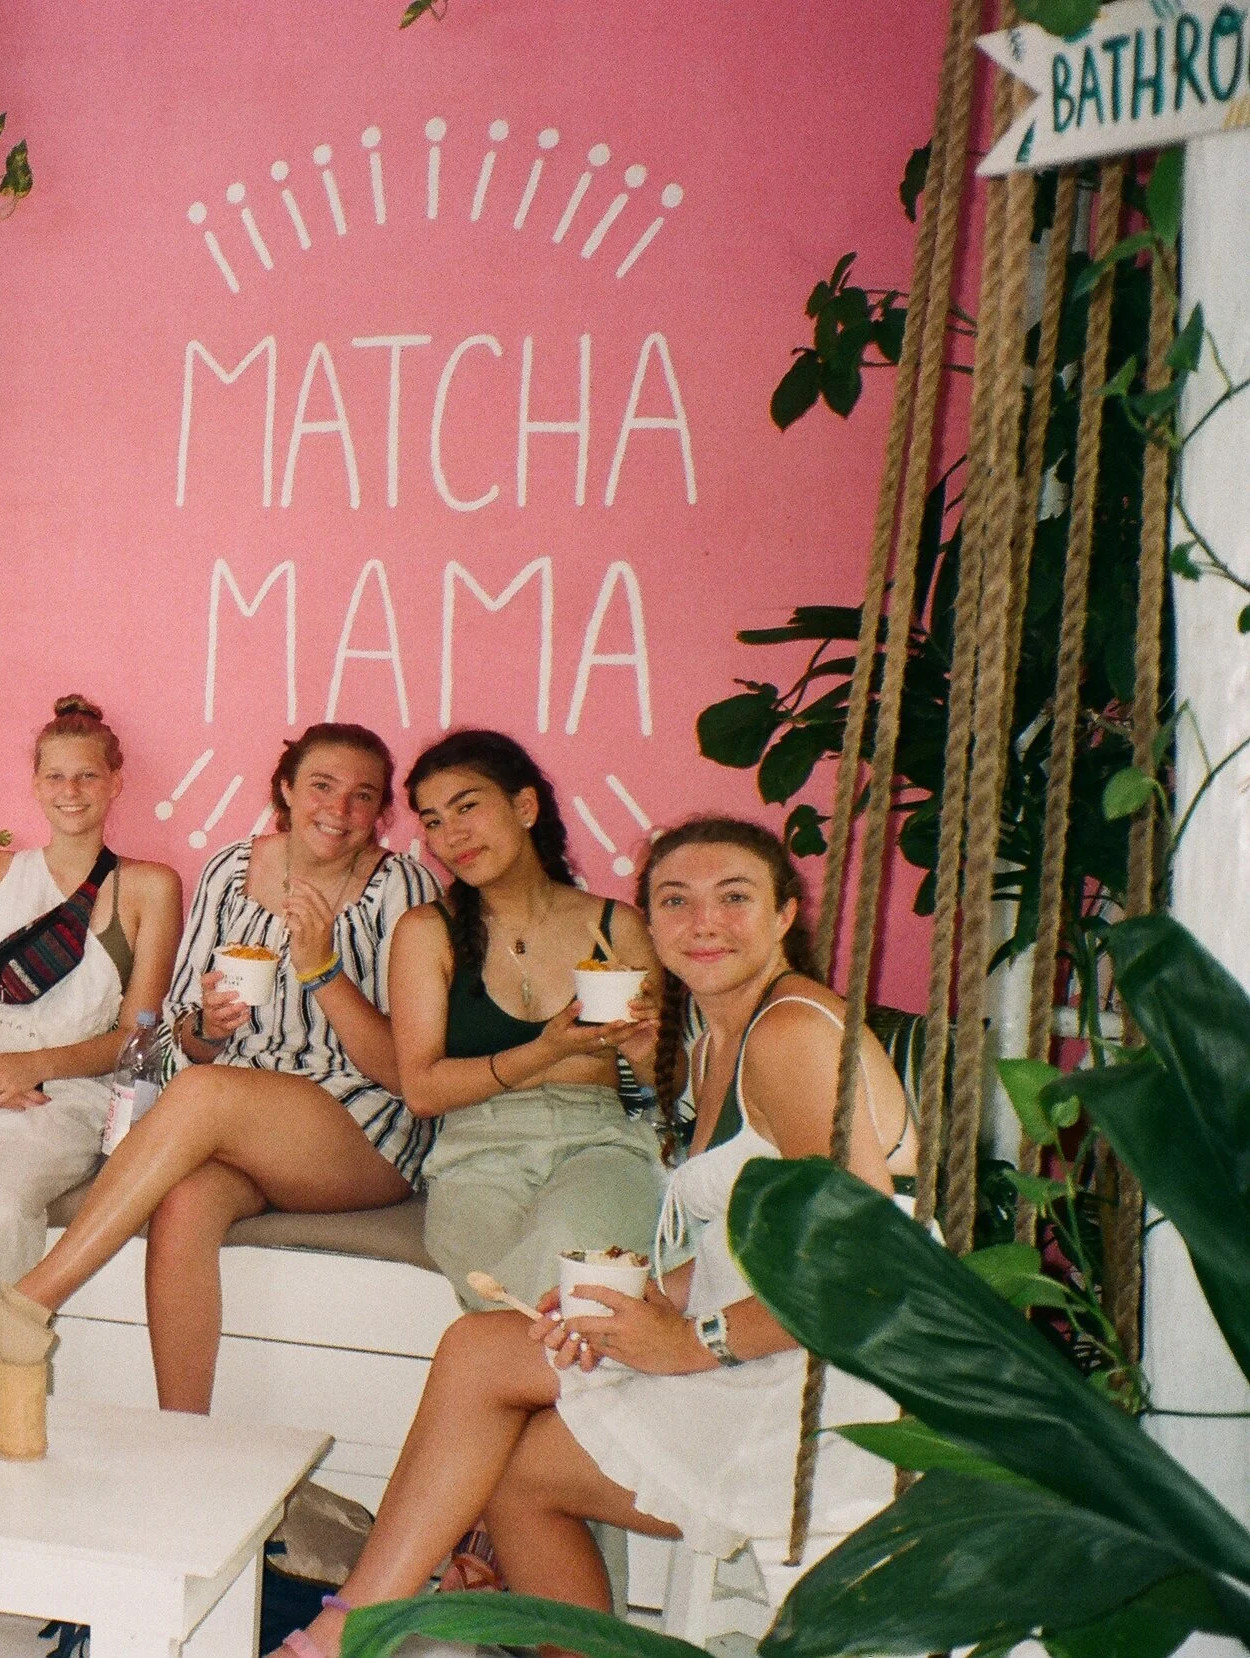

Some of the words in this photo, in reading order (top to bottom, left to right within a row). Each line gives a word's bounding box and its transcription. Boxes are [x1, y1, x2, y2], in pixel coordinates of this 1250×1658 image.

[1052, 4, 1250, 133] BATHRO
[175, 332, 697, 511] MATCHA
[203, 556, 653, 736] MAMA
